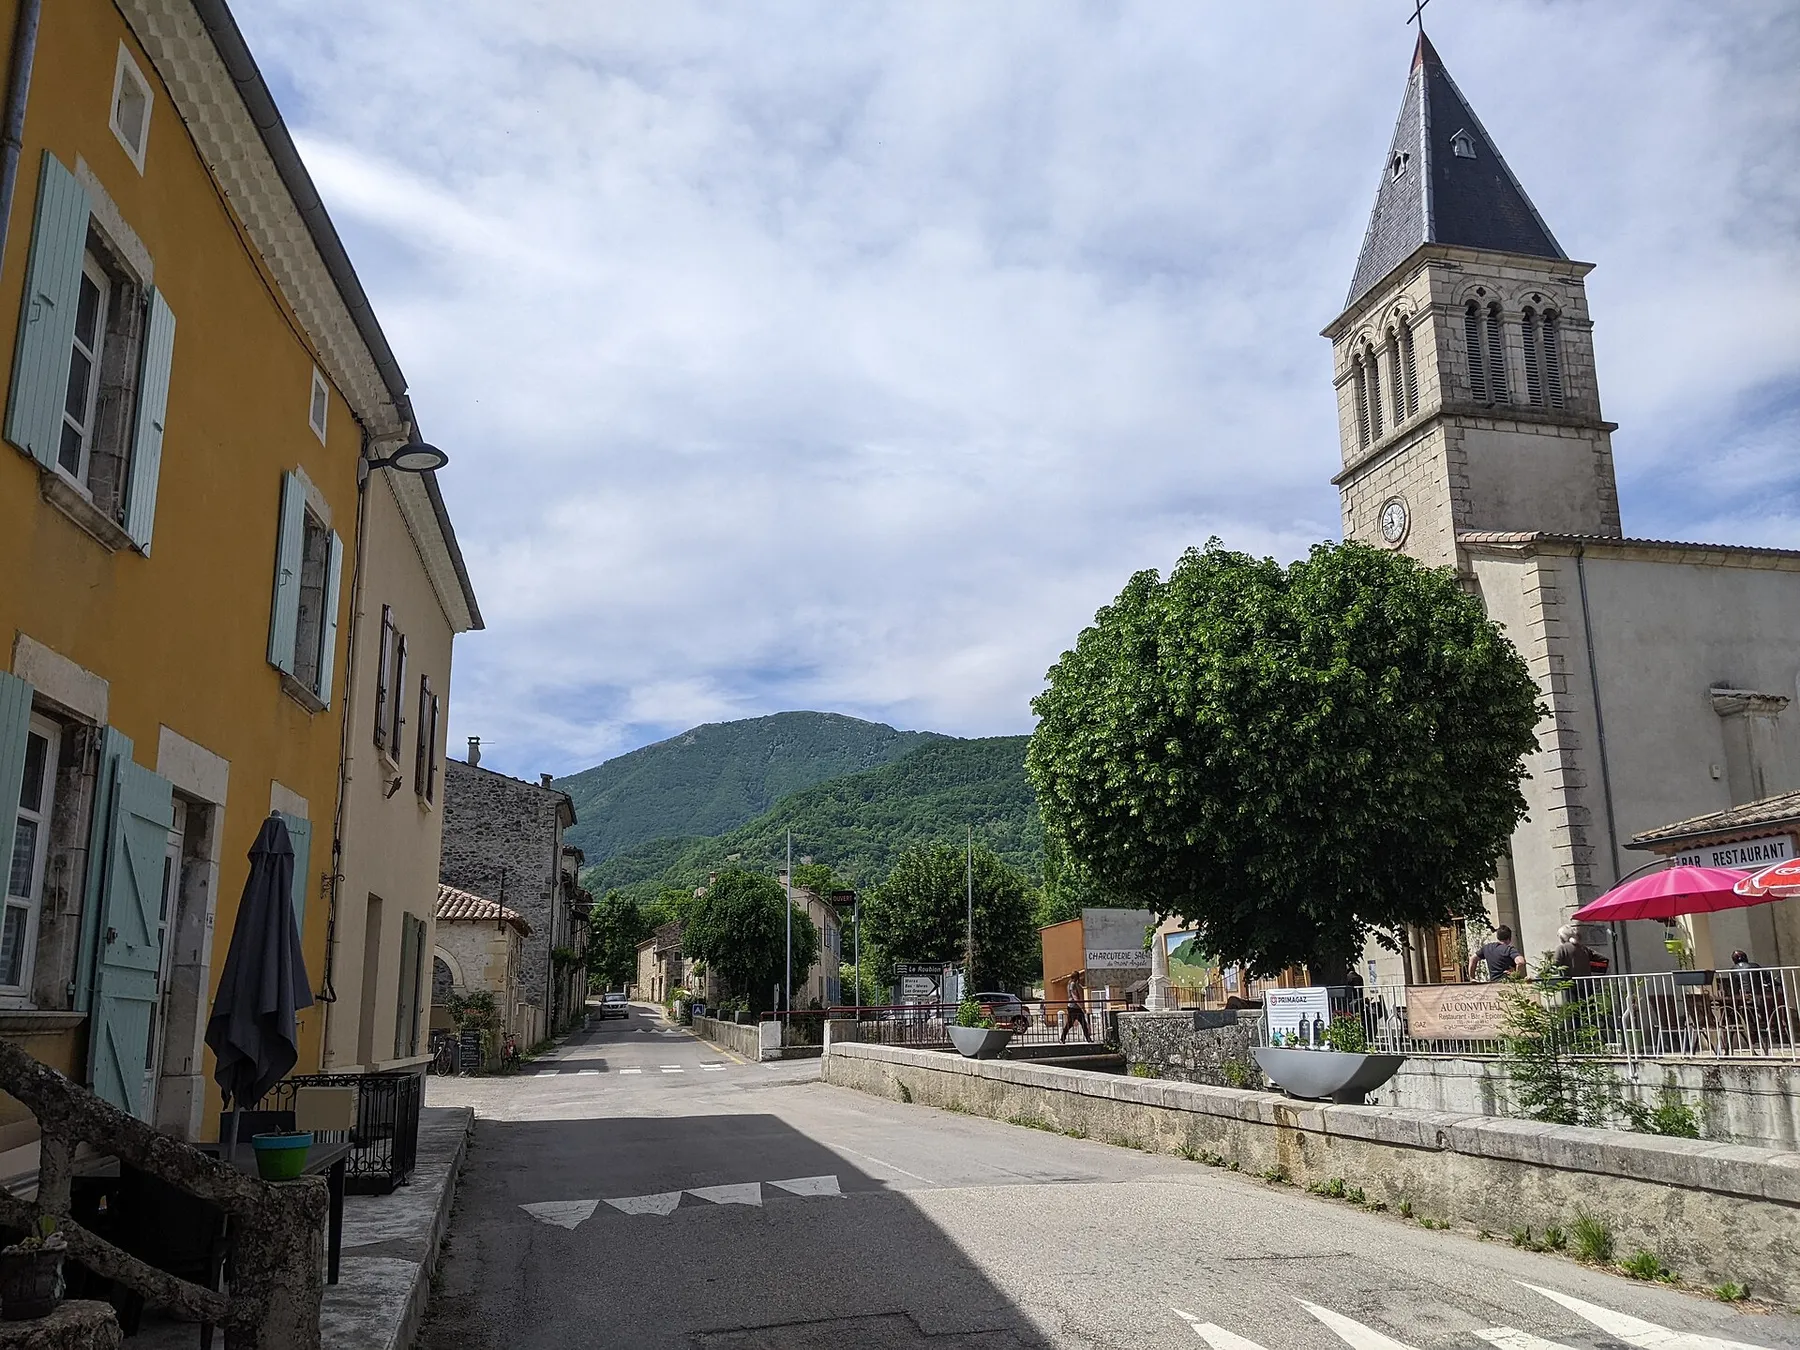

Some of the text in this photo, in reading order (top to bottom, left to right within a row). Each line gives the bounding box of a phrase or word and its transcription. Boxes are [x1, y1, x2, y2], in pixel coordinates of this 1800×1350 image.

[1681, 843, 1784, 868] BAR RESTAURANT
[1089, 951, 1131, 960] CHARCUTERIE
[1440, 1003, 1453, 1012] AU
